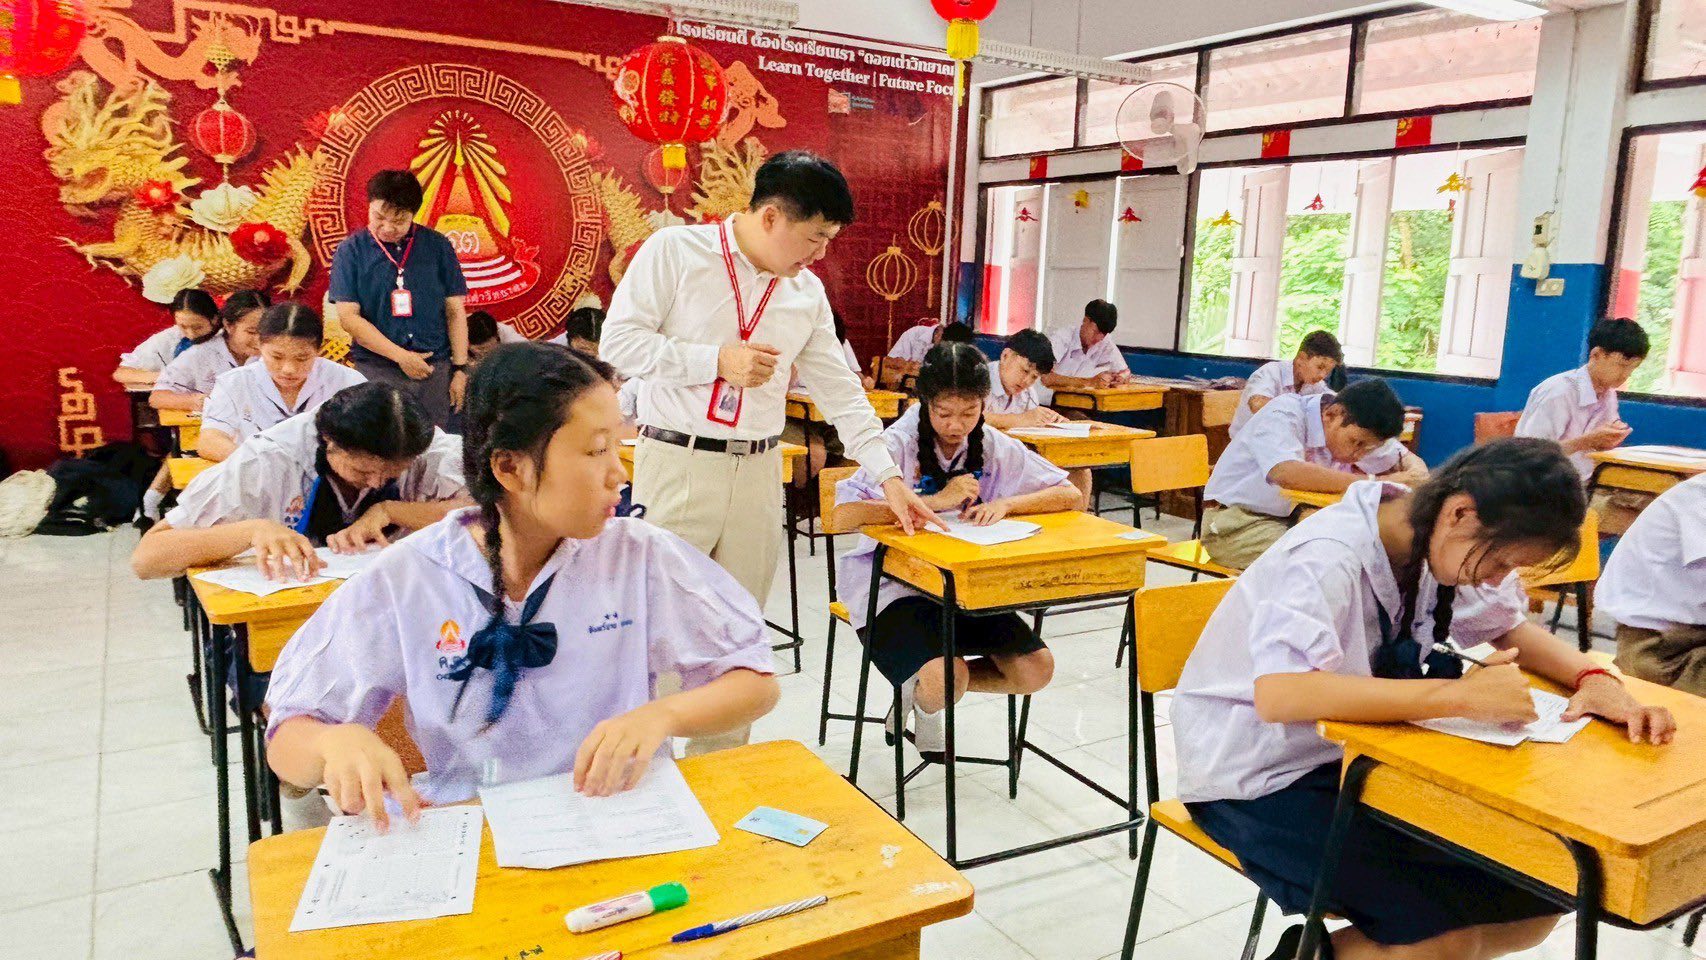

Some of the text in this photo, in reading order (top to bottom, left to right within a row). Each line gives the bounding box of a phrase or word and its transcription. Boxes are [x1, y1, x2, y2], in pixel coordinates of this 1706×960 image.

[758, 55, 803, 76] Learn
[805, 62, 870, 86] Together
[879, 73, 925, 92] Future
